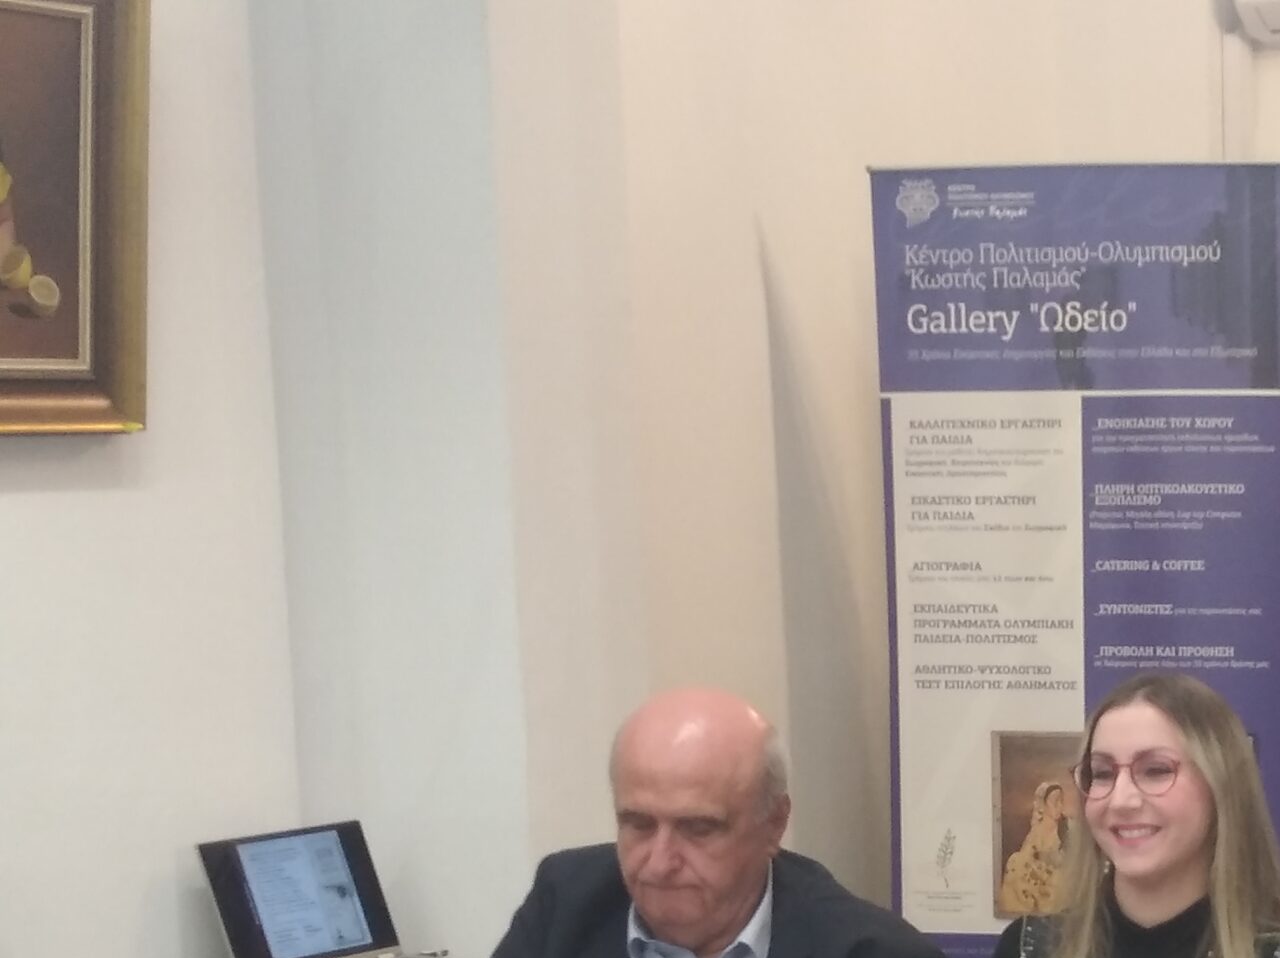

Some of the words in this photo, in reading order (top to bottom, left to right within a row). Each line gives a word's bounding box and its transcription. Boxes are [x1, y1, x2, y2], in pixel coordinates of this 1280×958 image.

[904, 244, 974, 269] Κέντρο
[979, 240, 1222, 268] Πολιτισμού-Ολυμπισμού
[906, 302, 1020, 342] Gallery
[1030, 301, 1137, 333] "Ωδείο"
[1000, 418, 1063, 429] ΕΡΓΑΣΤΗΡΙ
[1170, 417, 1192, 428] ΤΟΥ
[1194, 417, 1235, 429] ΧΩΡΟΥ
[909, 434, 929, 446] ΓΙΑ
[931, 434, 974, 446] ΠΑΙΔΙΑ
[910, 495, 973, 506] ΕΙΚΑΣΤΙΚΟ
[975, 495, 1037, 506] ΕΡΓΑΣΤΗΡΙ
[911, 510, 930, 521] ΓΙΑ
[932, 510, 976, 521] ΠΑΙΔΙΑ
[912, 561, 983, 572] ΑΓΙΟΓΡΑΦΙΑ
[1152, 560, 1162, 571] &
[1162, 560, 1206, 571] COFFEE
[912, 603, 999, 614] ΕΚΠΑΙΔΕΥΤΙΚΑ
[913, 618, 1001, 630] ΠΡΟΓΡΑΜΜΑΤΑ
[1003, 619, 1075, 630] ΟΛΥΜΠΙΑΚΗ
[1156, 646, 1176, 657] ΚΑΙ
[914, 680, 941, 690] ΤΕΣΤ
[944, 680, 1004, 690] ΕΠΙΛΟΓΗΣ
[1006, 680, 1078, 691] ΑΘΛΗΜΑΤΟΣ
